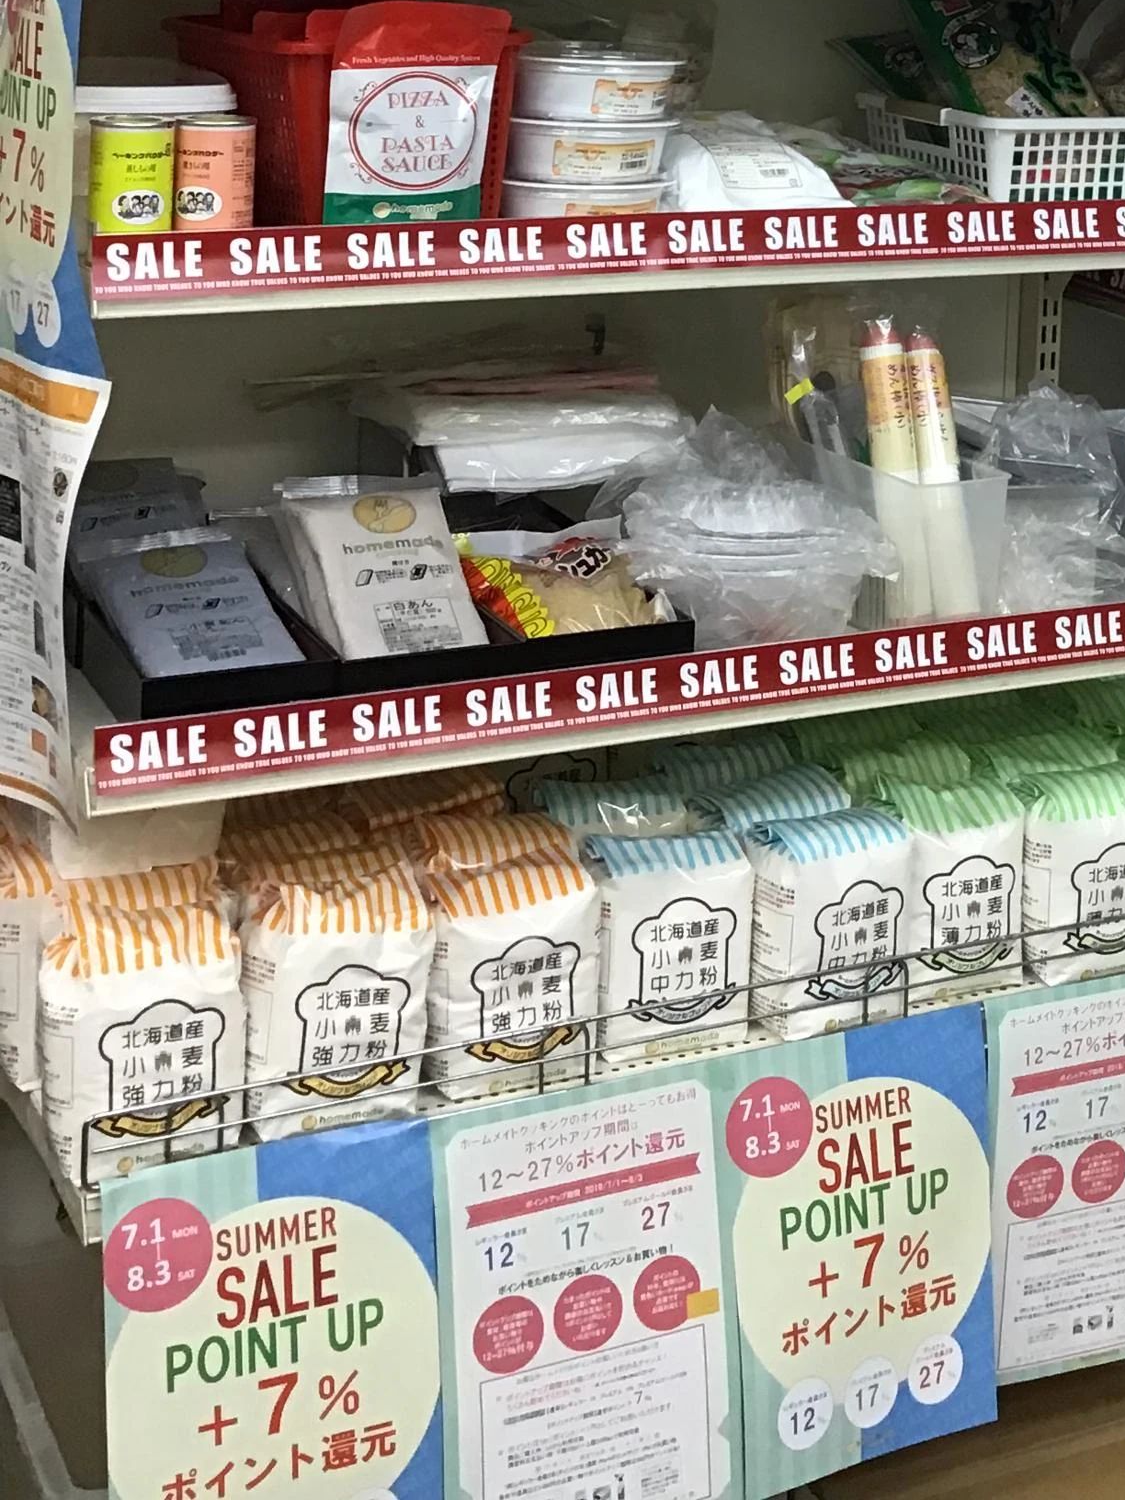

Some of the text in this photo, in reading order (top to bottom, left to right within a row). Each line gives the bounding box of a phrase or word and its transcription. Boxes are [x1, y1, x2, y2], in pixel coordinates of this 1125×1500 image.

[11, 17, 43, 80] ALE
[36, 87, 57, 132] UP
[388, 91, 450, 109] PIZZA
[382, 135, 455, 153] PASTA
[381, 154, 453, 173] SAUCE
[107, 242, 204, 282] SALE
[347, 231, 436, 270] SALE
[668, 218, 745, 254] SALE
[947, 210, 1016, 243] SALE
[109, 725, 207, 775] SALE
[352, 695, 442, 743] SALE
[680, 655, 758, 699] SALE
[967, 621, 1037, 662] SALE
[943, 874, 1003, 897] 北海道産
[650, 918, 720, 943] 北海道産
[491, 951, 564, 981] 北海道産
[650, 966, 718, 993] 中力粉
[316, 987, 391, 1011] 北海道産
[491, 1001, 563, 1032] 強力粉
[122, 1020, 205, 1050] 北海道産
[311, 1041, 388, 1067] 強力粉
[122, 1074, 204, 1109] 強力粉
[740, 1093, 775, 1122] 7.1
[815, 1086, 911, 1133] SUMMER
[745, 1132, 781, 1159] 8.3
[818, 1120, 915, 1195] SALE
[780, 1168, 949, 1250] POINT UP
[121, 1218, 166, 1250] 7.1
[216, 1206, 337, 1261] SUMMER
[127, 1260, 171, 1292] 8.3
[217, 1243, 339, 1329] SALE
[782, 1273, 956, 1357] ポイント還元
[165, 1298, 384, 1394] POINT UP
[919, 1361, 945, 1389] 27
[161, 1421, 397, 1500] ポイント還元
